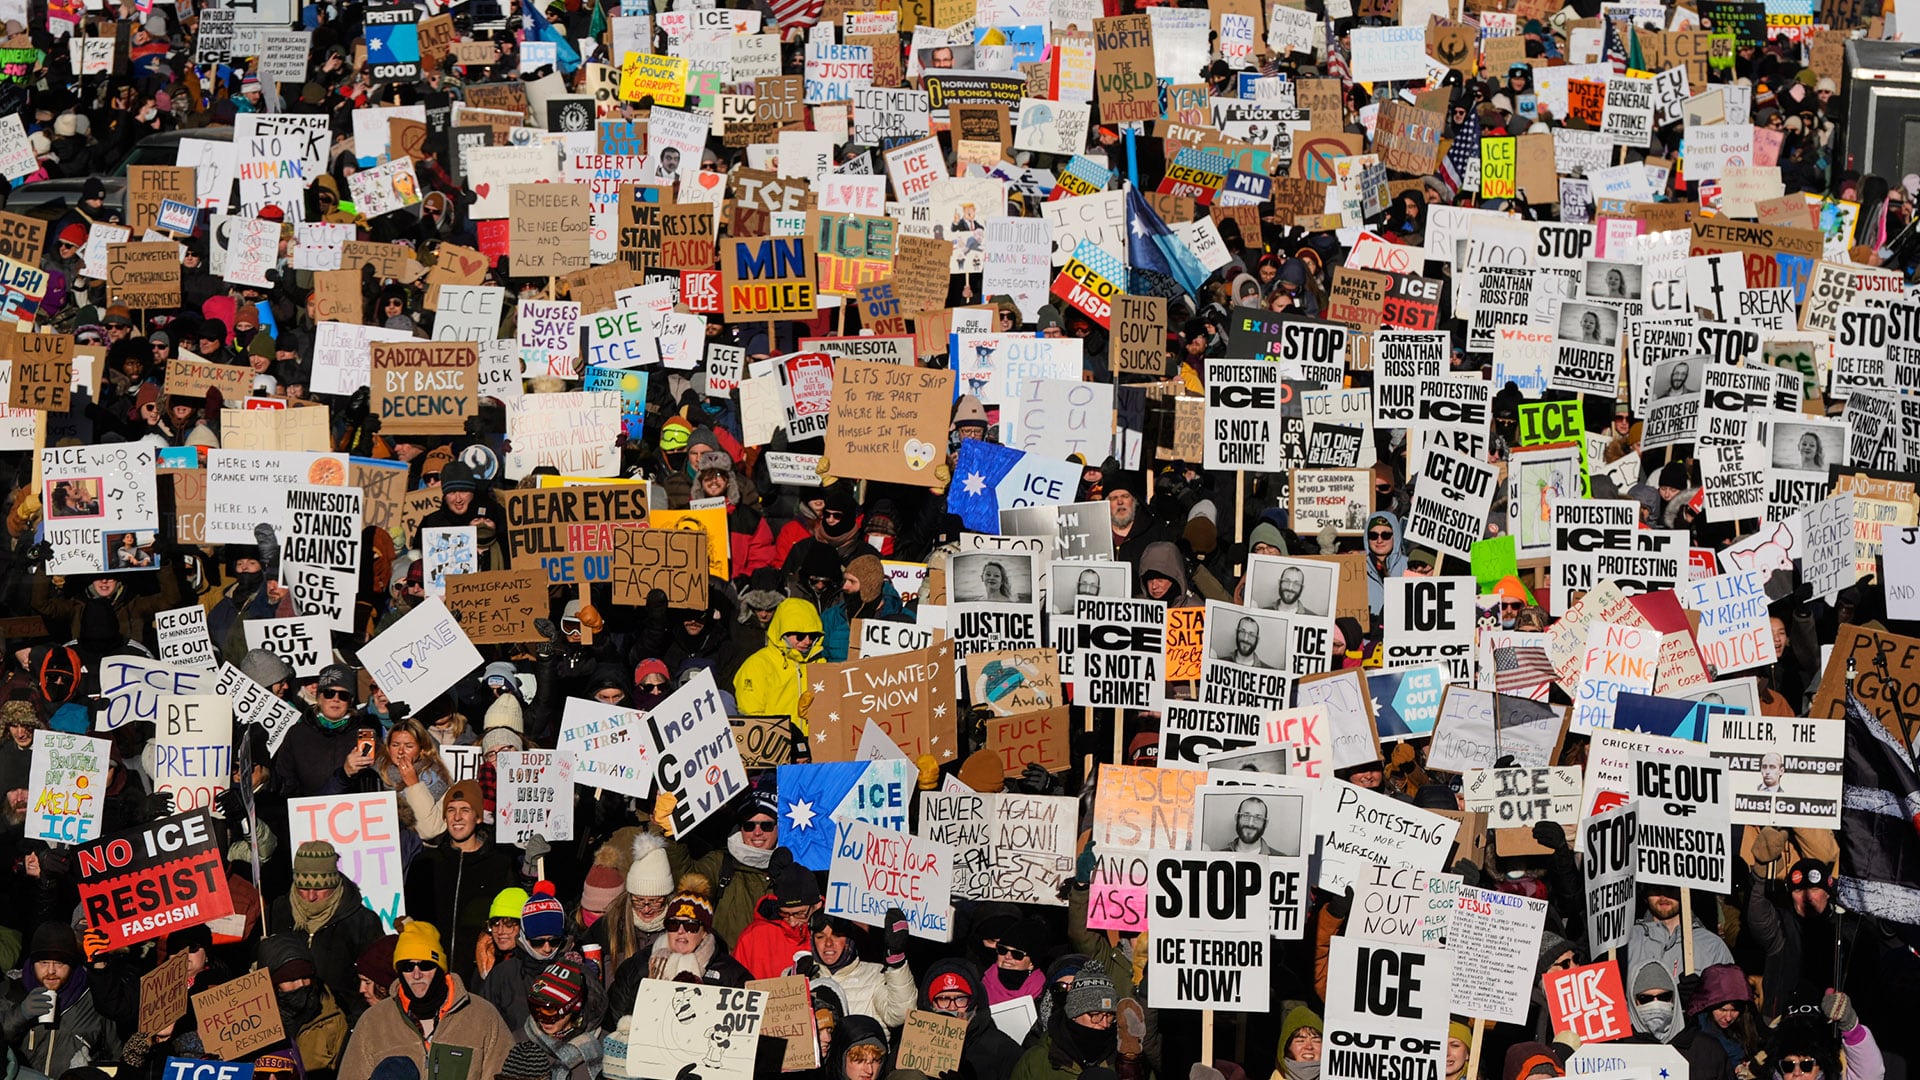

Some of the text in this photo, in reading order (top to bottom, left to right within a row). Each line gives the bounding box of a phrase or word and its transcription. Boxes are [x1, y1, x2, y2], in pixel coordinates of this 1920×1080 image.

[202, 11, 235, 21] MN GOLDEN
[367, 10, 413, 24] PRETTI
[1094, 19, 1149, 32] WE ARE THE
[1226, 17, 1248, 27] MN
[200, 22, 234, 34] GOPHERS
[1223, 28, 1252, 39] NICE
[199, 37, 232, 50] AGAINST
[1098, 32, 1150, 50] NORTH
[198, 51, 231, 63] ICE
[816, 43, 868, 60] LIBERTY
[636, 54, 681, 69] ABSOLUTE
[820, 62, 873, 78] JUSTICE
[1113, 62, 1132, 74] THE
[373, 65, 416, 78] GOOD
[640, 66, 675, 80] POWER
[634, 78, 681, 93] CORRUPTS
[758, 78, 798, 99] ICE
[806, 80, 851, 100] FOR ALL
[1100, 73, 1153, 92] WORLD
[1640, 83, 1653, 93] THE
[1120, 91, 1134, 103] IS
[1608, 93, 1650, 109] GENERAL
[759, 100, 796, 120] OUT
[1101, 101, 1157, 120] WATCHING
[1608, 115, 1647, 129] STRIKE!
[1696, 131, 1715, 140] This
[1721, 130, 1729, 139] is
[252, 139, 281, 156] NO
[1487, 143, 1510, 160] ICE
[1687, 143, 1749, 155] Pretti Good
[240, 160, 302, 179] HUMAN
[1485, 164, 1512, 179] OUT
[1695, 160, 1714, 171] sign
[264, 183, 280, 197] IS
[1484, 180, 1513, 196] NOW
[515, 191, 580, 207] REMEBER
[518, 219, 557, 232] RENEE
[662, 214, 713, 235] RESIST
[538, 237, 560, 246] AND
[1694, 223, 1822, 252] VETERANS AGAINST
[516, 253, 588, 266] ALEX PRETTI
[662, 240, 714, 267] FASCISM
[737, 239, 805, 280] MN
[1856, 274, 1904, 293] JUSTICE
[1121, 299, 1157, 322] THIS
[1740, 290, 1792, 314] BREAK
[532, 320, 575, 335] SAVE
[595, 312, 641, 339] BYE
[1120, 325, 1163, 343] GOV'T
[23, 338, 63, 354] LOVE
[592, 340, 640, 364] ICE
[374, 348, 476, 367] RADICALIZED
[1120, 349, 1162, 371] SUCKS
[1559, 347, 1614, 372] MURDER
[20, 363, 71, 382] MELTS
[386, 371, 464, 392] BY BASIC
[843, 367, 947, 388] LETS JUST SKIP
[1210, 366, 1276, 382] PROTESTING
[1554, 366, 1614, 384] NOW!
[21, 387, 62, 405] ICE
[845, 390, 922, 403] TO THE PART
[1210, 386, 1275, 408] ICE
[383, 397, 468, 417] DECENCY
[837, 406, 871, 419] WHERE
[838, 425, 917, 436] HIMSELF IN THE
[1215, 420, 1269, 441] IS NOT A
[1522, 404, 1578, 440] ICE
[846, 441, 888, 454] BUNKER
[1219, 444, 1264, 464] CRIME!
[218, 458, 279, 468] HERE IS AN
[211, 473, 245, 483] ORANGE
[274, 474, 298, 483] SEEDS
[1705, 472, 1764, 490] DOMESTIC
[510, 490, 646, 525] CLEAR EYES
[1707, 488, 1764, 508] TERRORISTS
[50, 529, 100, 545] JUSTICE
[511, 526, 563, 557] FULL
[1405, 582, 1455, 631] ICE
[1388, 645, 1470, 656] OUT OF
[841, 663, 939, 697] I WANTED
[859, 689, 918, 713] SNOW
[168, 704, 202, 735] BE
[999, 718, 1053, 742] FUCK
[1723, 720, 1816, 744] MILLER, THE
[157, 746, 231, 777] PRETTI
[999, 739, 1052, 771] ICE
[1785, 759, 1842, 772] Monger
[1636, 761, 1721, 803] ICE OUT
[1664, 803, 1696, 816] OF
[1735, 796, 1836, 815] Must Go Now!
[1337, 788, 1445, 845] PROTESTING
[78, 815, 209, 877] NO ICE
[1326, 831, 1387, 864] AMERICAN
[1638, 824, 1725, 856] MINNESOTA
[866, 832, 901, 868] RAISE
[1638, 848, 1724, 883] FOR GOOD!
[86, 860, 219, 928] RESIST
[862, 868, 925, 901] VOICE,
[1156, 859, 1261, 920] STOP
[1459, 898, 1491, 915] JESUS
[122, 903, 200, 937] FASCISM
[1157, 938, 1262, 966] ICE TERROR
[199, 972, 267, 1008] MINNESOTA
[1178, 968, 1241, 1002] NOW!
[716, 989, 761, 1011] ICE
[204, 993, 271, 1033] PRETTI
[219, 1015, 261, 1041] GOOD
[724, 1013, 759, 1033] OUT
